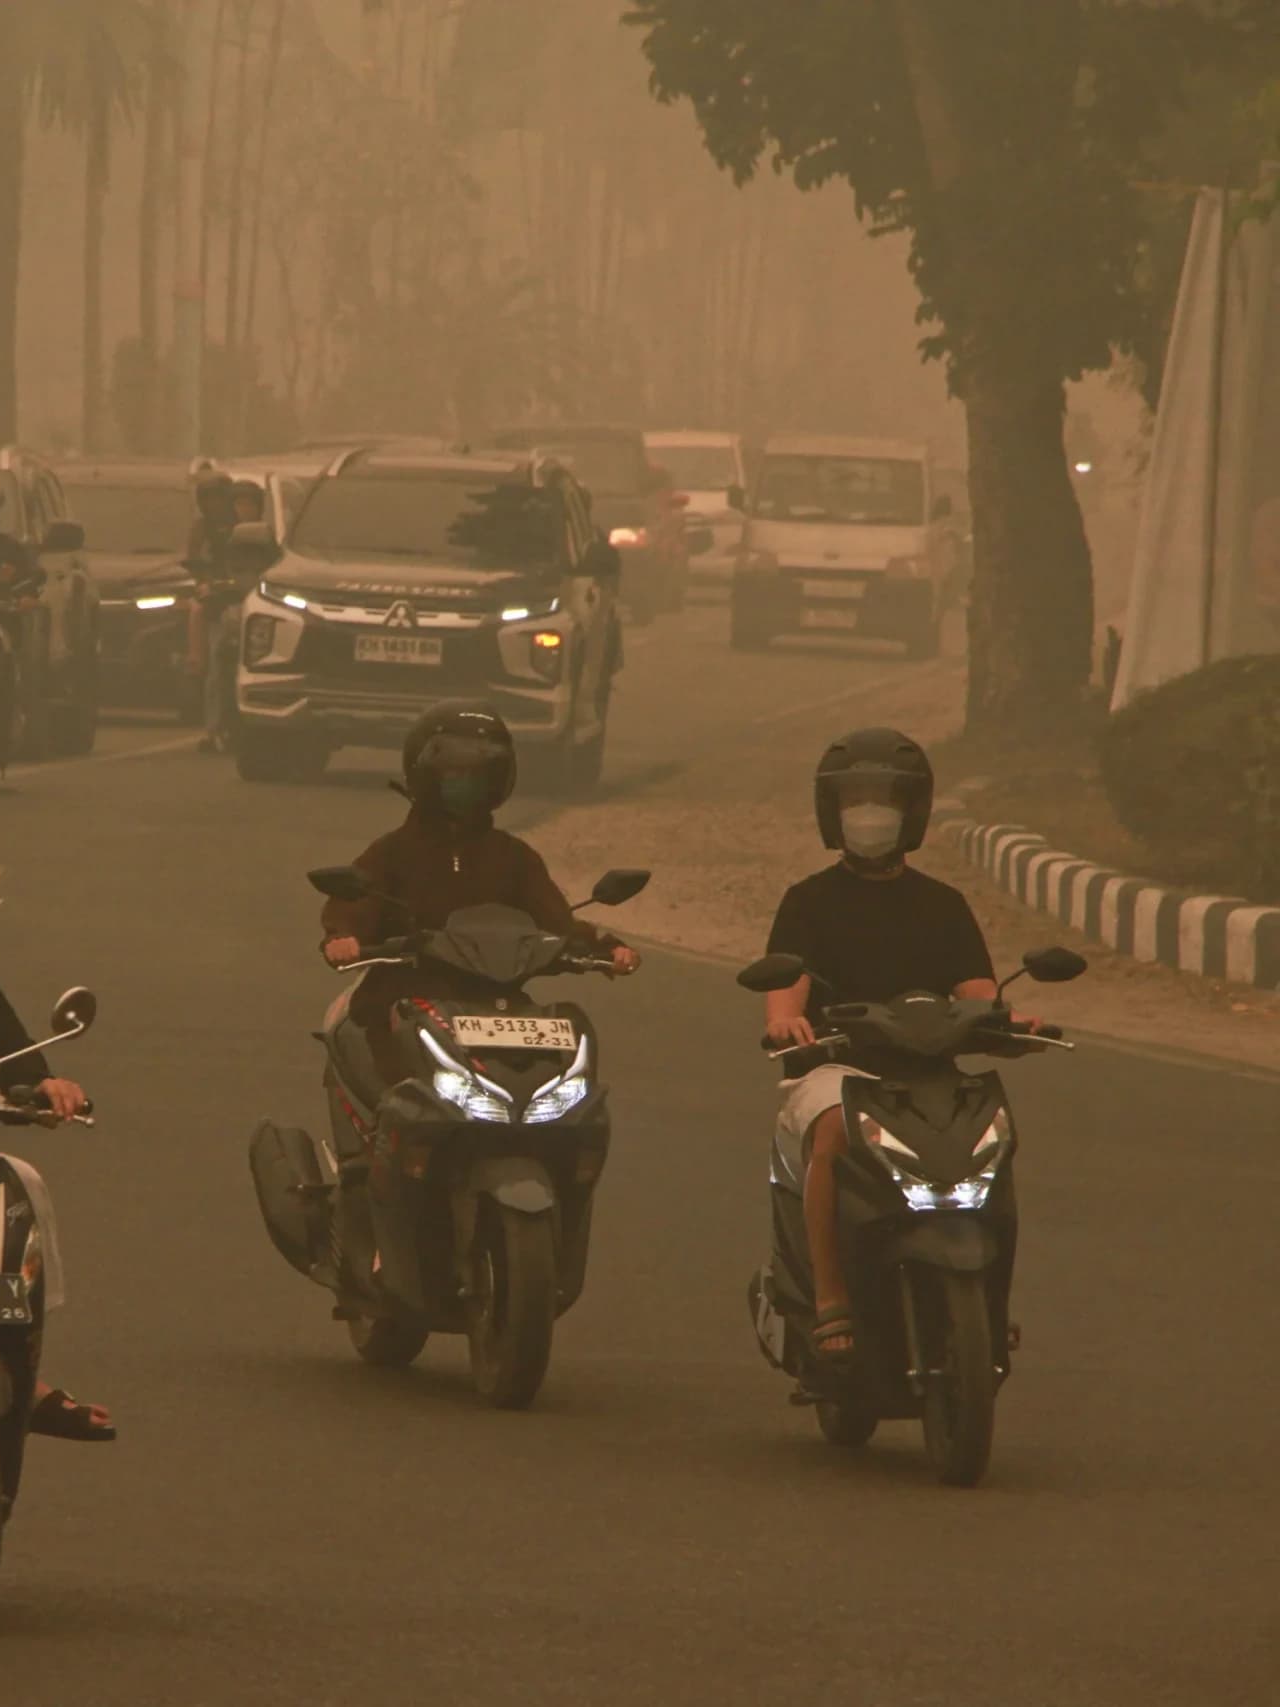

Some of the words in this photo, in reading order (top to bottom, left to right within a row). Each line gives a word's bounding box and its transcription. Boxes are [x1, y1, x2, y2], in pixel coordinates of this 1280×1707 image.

[457, 1019, 482, 1031] KH
[493, 1019, 538, 1033] 5133
[549, 1021, 570, 1034] JN
[7, 1279, 20, 1299] Y
